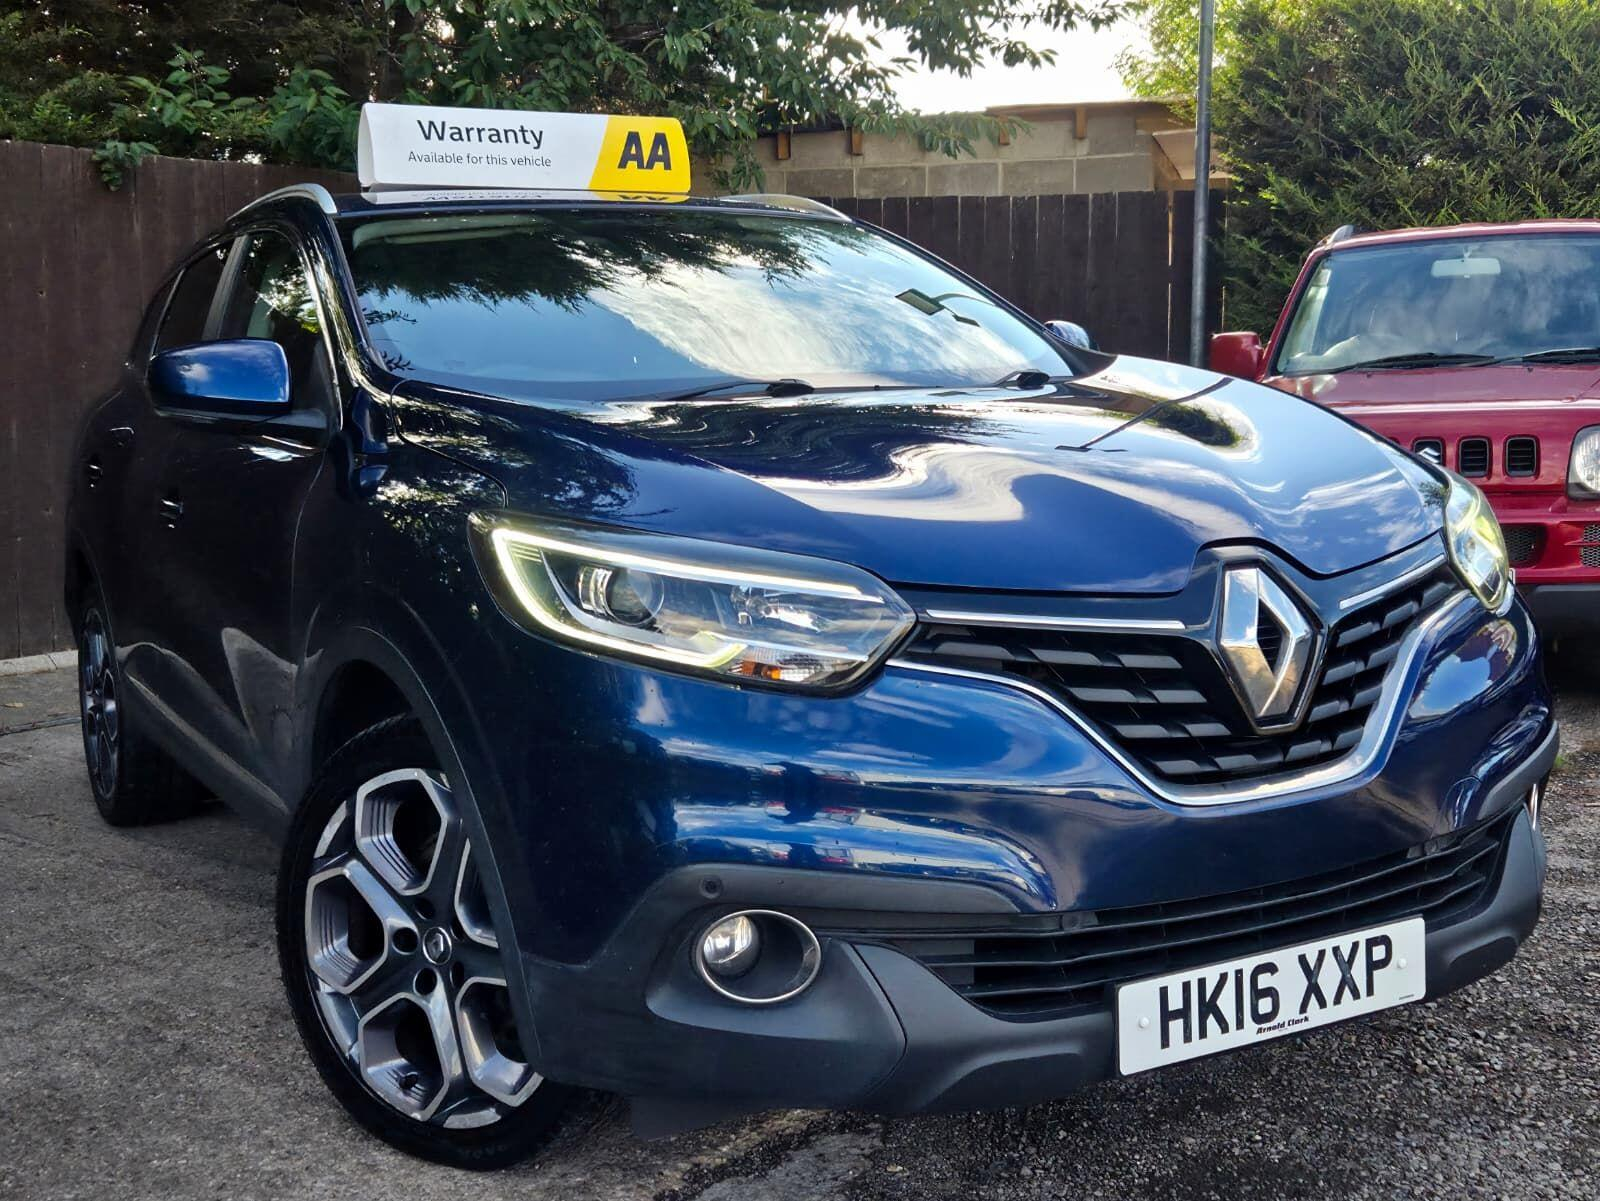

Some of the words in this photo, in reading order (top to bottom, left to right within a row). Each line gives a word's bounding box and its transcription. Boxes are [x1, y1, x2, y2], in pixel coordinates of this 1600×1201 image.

[417, 119, 543, 149] Warranty
[408, 151, 463, 164] Available
[466, 153, 483, 165] for
[486, 154, 508, 165] this
[510, 155, 552, 167] vehicle
[617, 131, 672, 171] AA
[1159, 962, 1280, 1050] HK16
[1298, 934, 1393, 1014] XXP
[1256, 1021, 1286, 1035] Arnold
[1287, 1015, 1309, 1027] Clark
